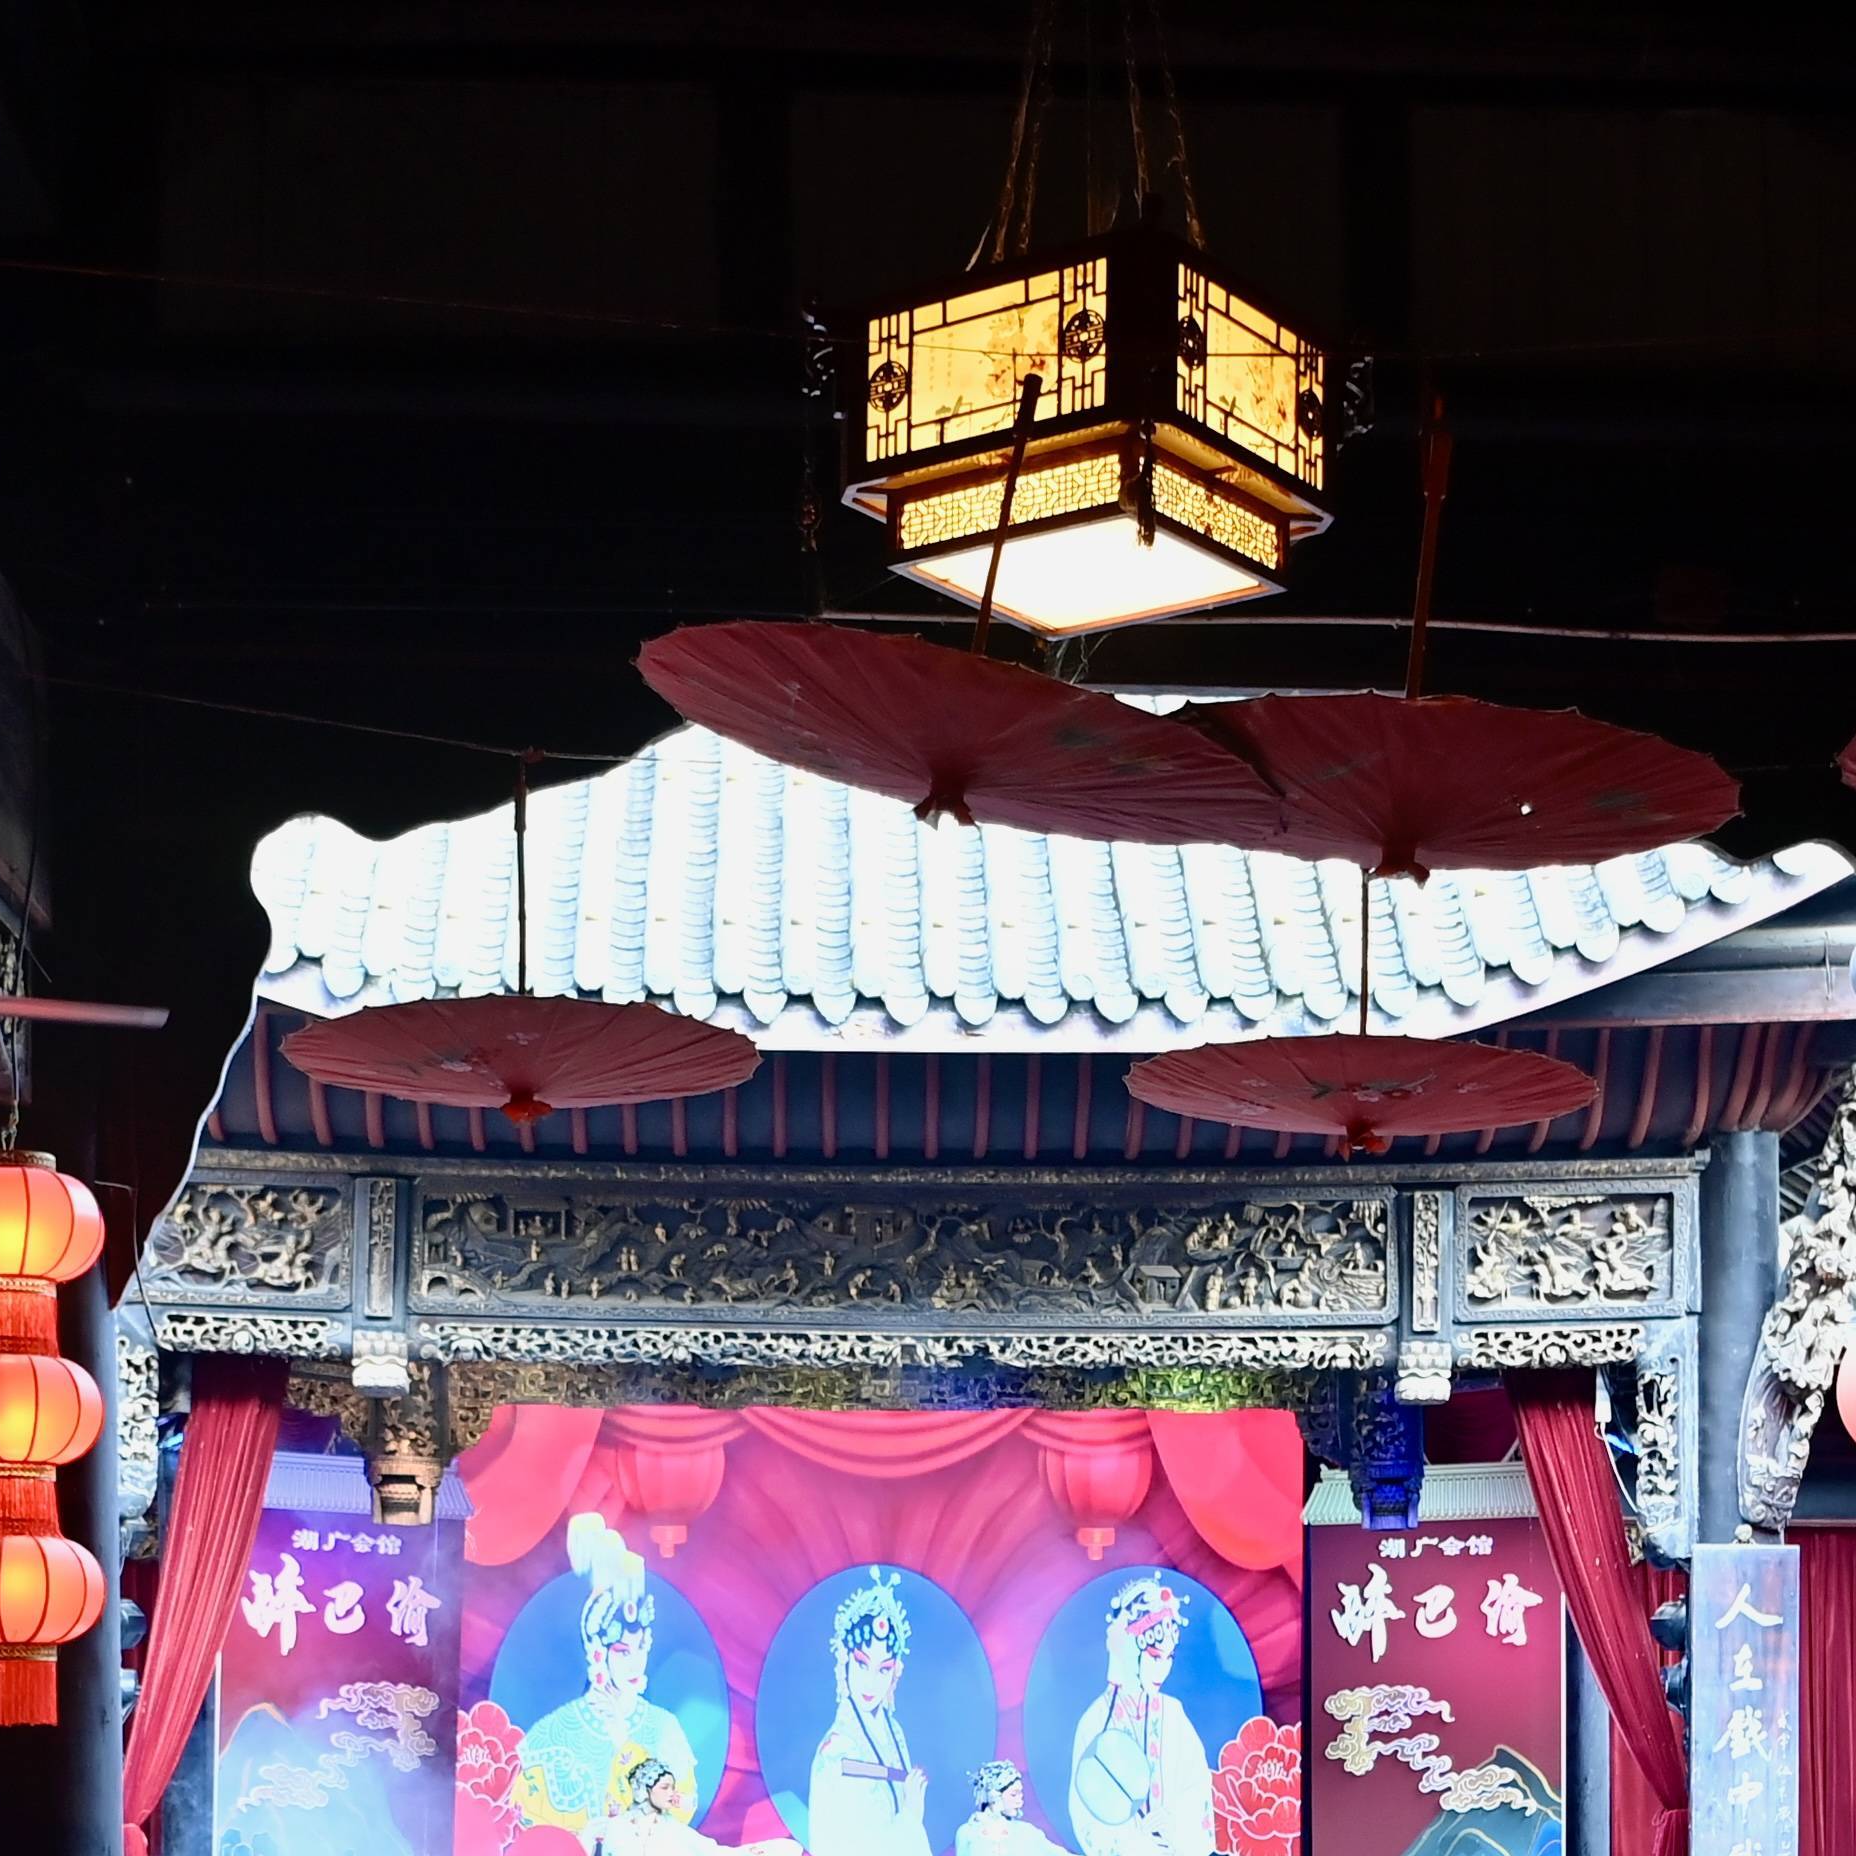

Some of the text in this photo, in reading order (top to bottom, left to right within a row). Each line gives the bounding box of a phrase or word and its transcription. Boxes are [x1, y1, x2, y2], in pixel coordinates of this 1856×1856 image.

[291, 1528, 403, 1555] 湖广会馆
[1378, 1535, 1494, 1558] 湖广会馆
